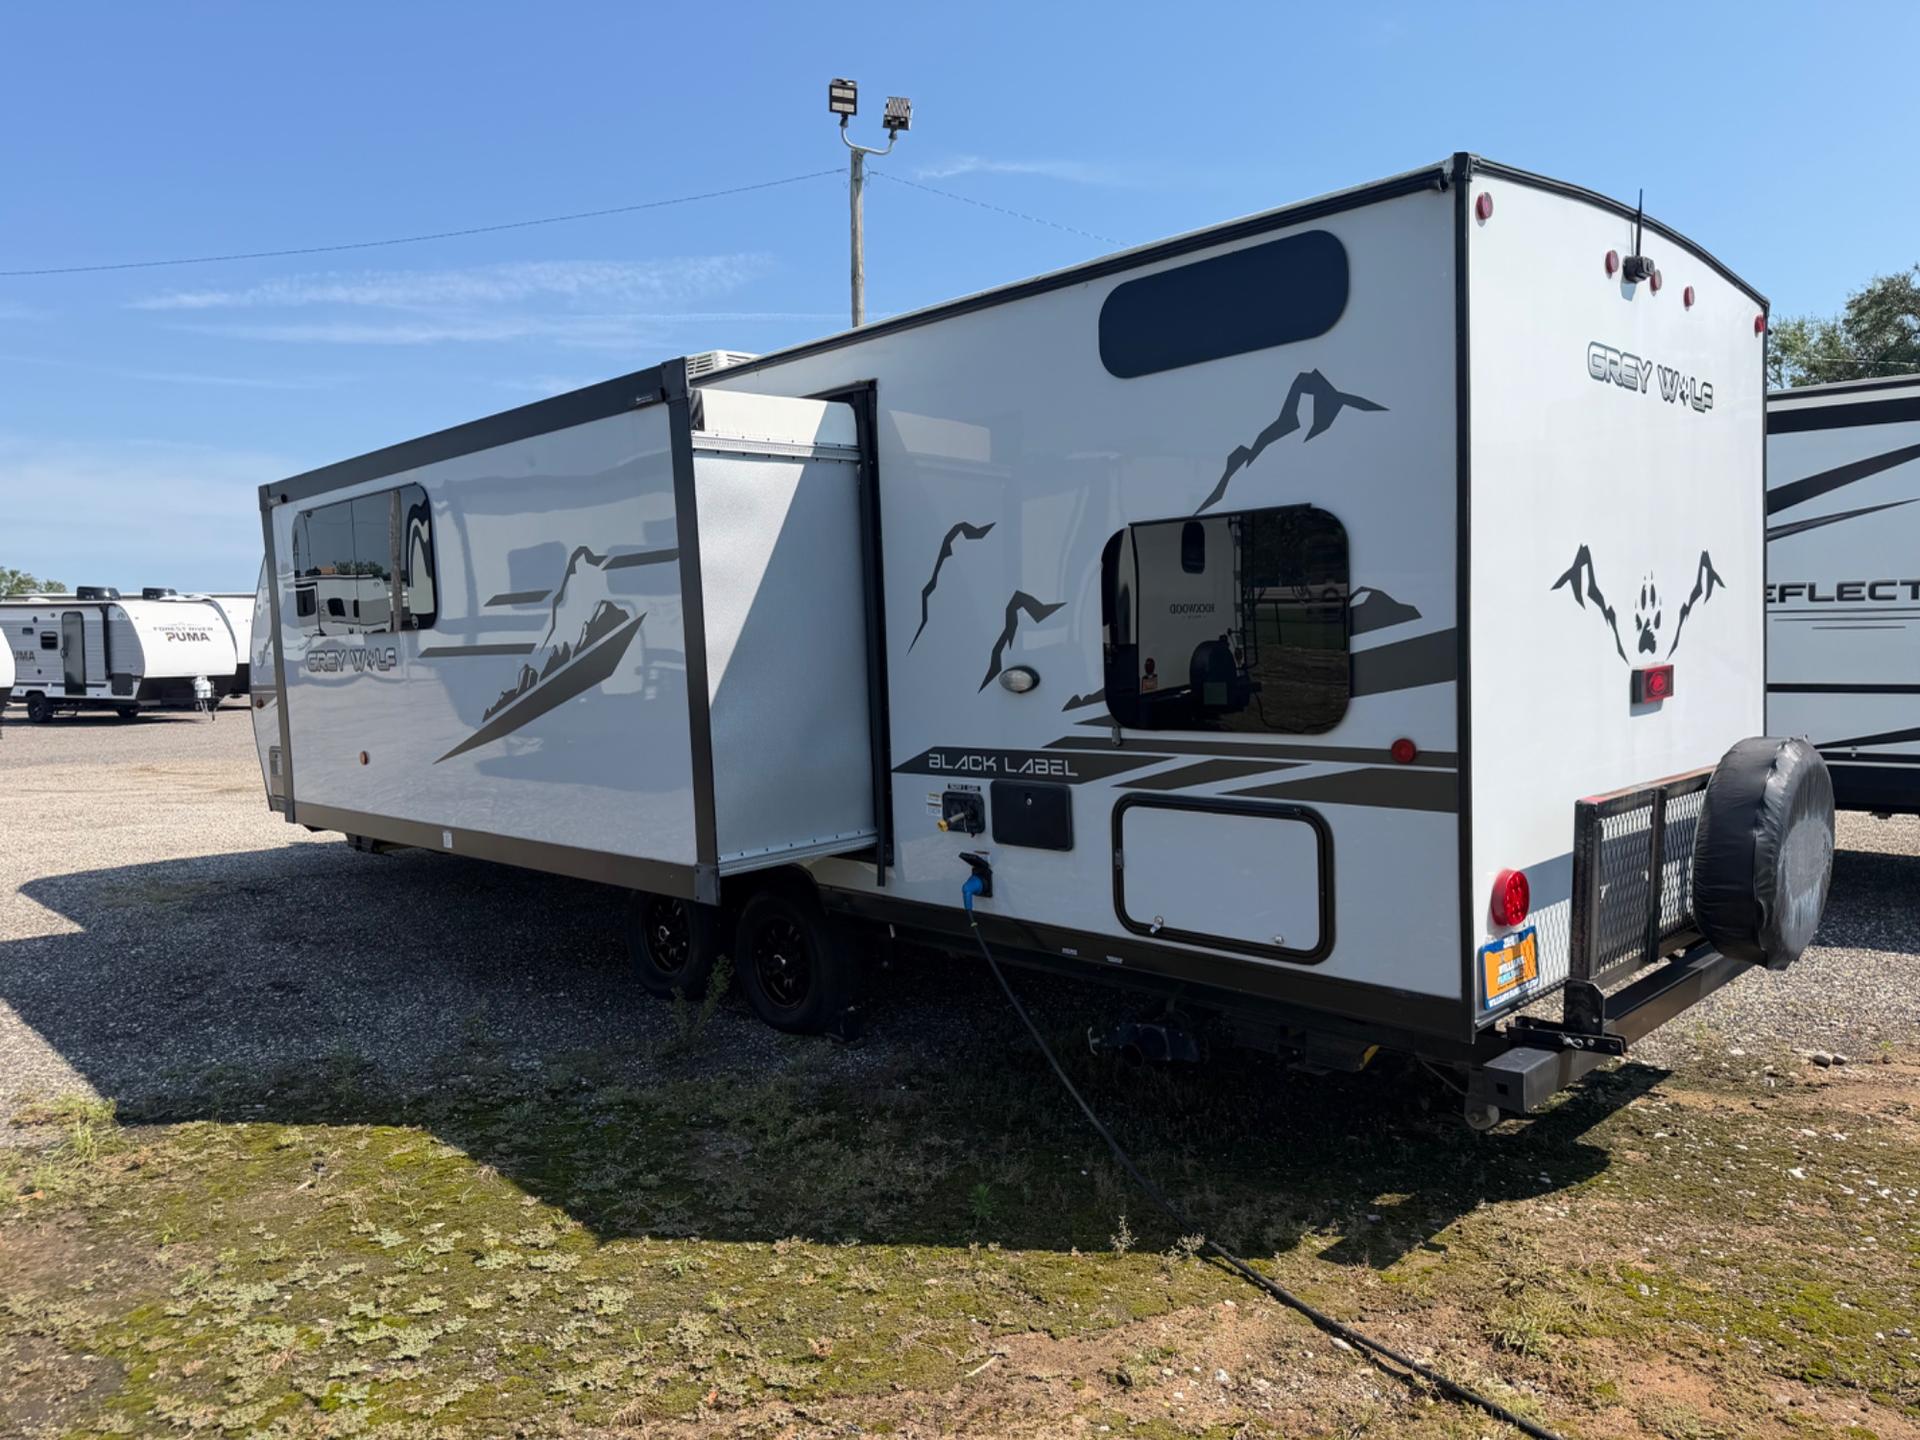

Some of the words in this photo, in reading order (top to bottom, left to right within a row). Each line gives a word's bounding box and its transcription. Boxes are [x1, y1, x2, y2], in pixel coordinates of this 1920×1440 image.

[1587, 341, 1652, 394] GREY
[165, 632, 211, 642] PUMA
[307, 650, 346, 672] GREY
[928, 753, 997, 772] BLACK
[1004, 757, 1079, 776] LABEL
